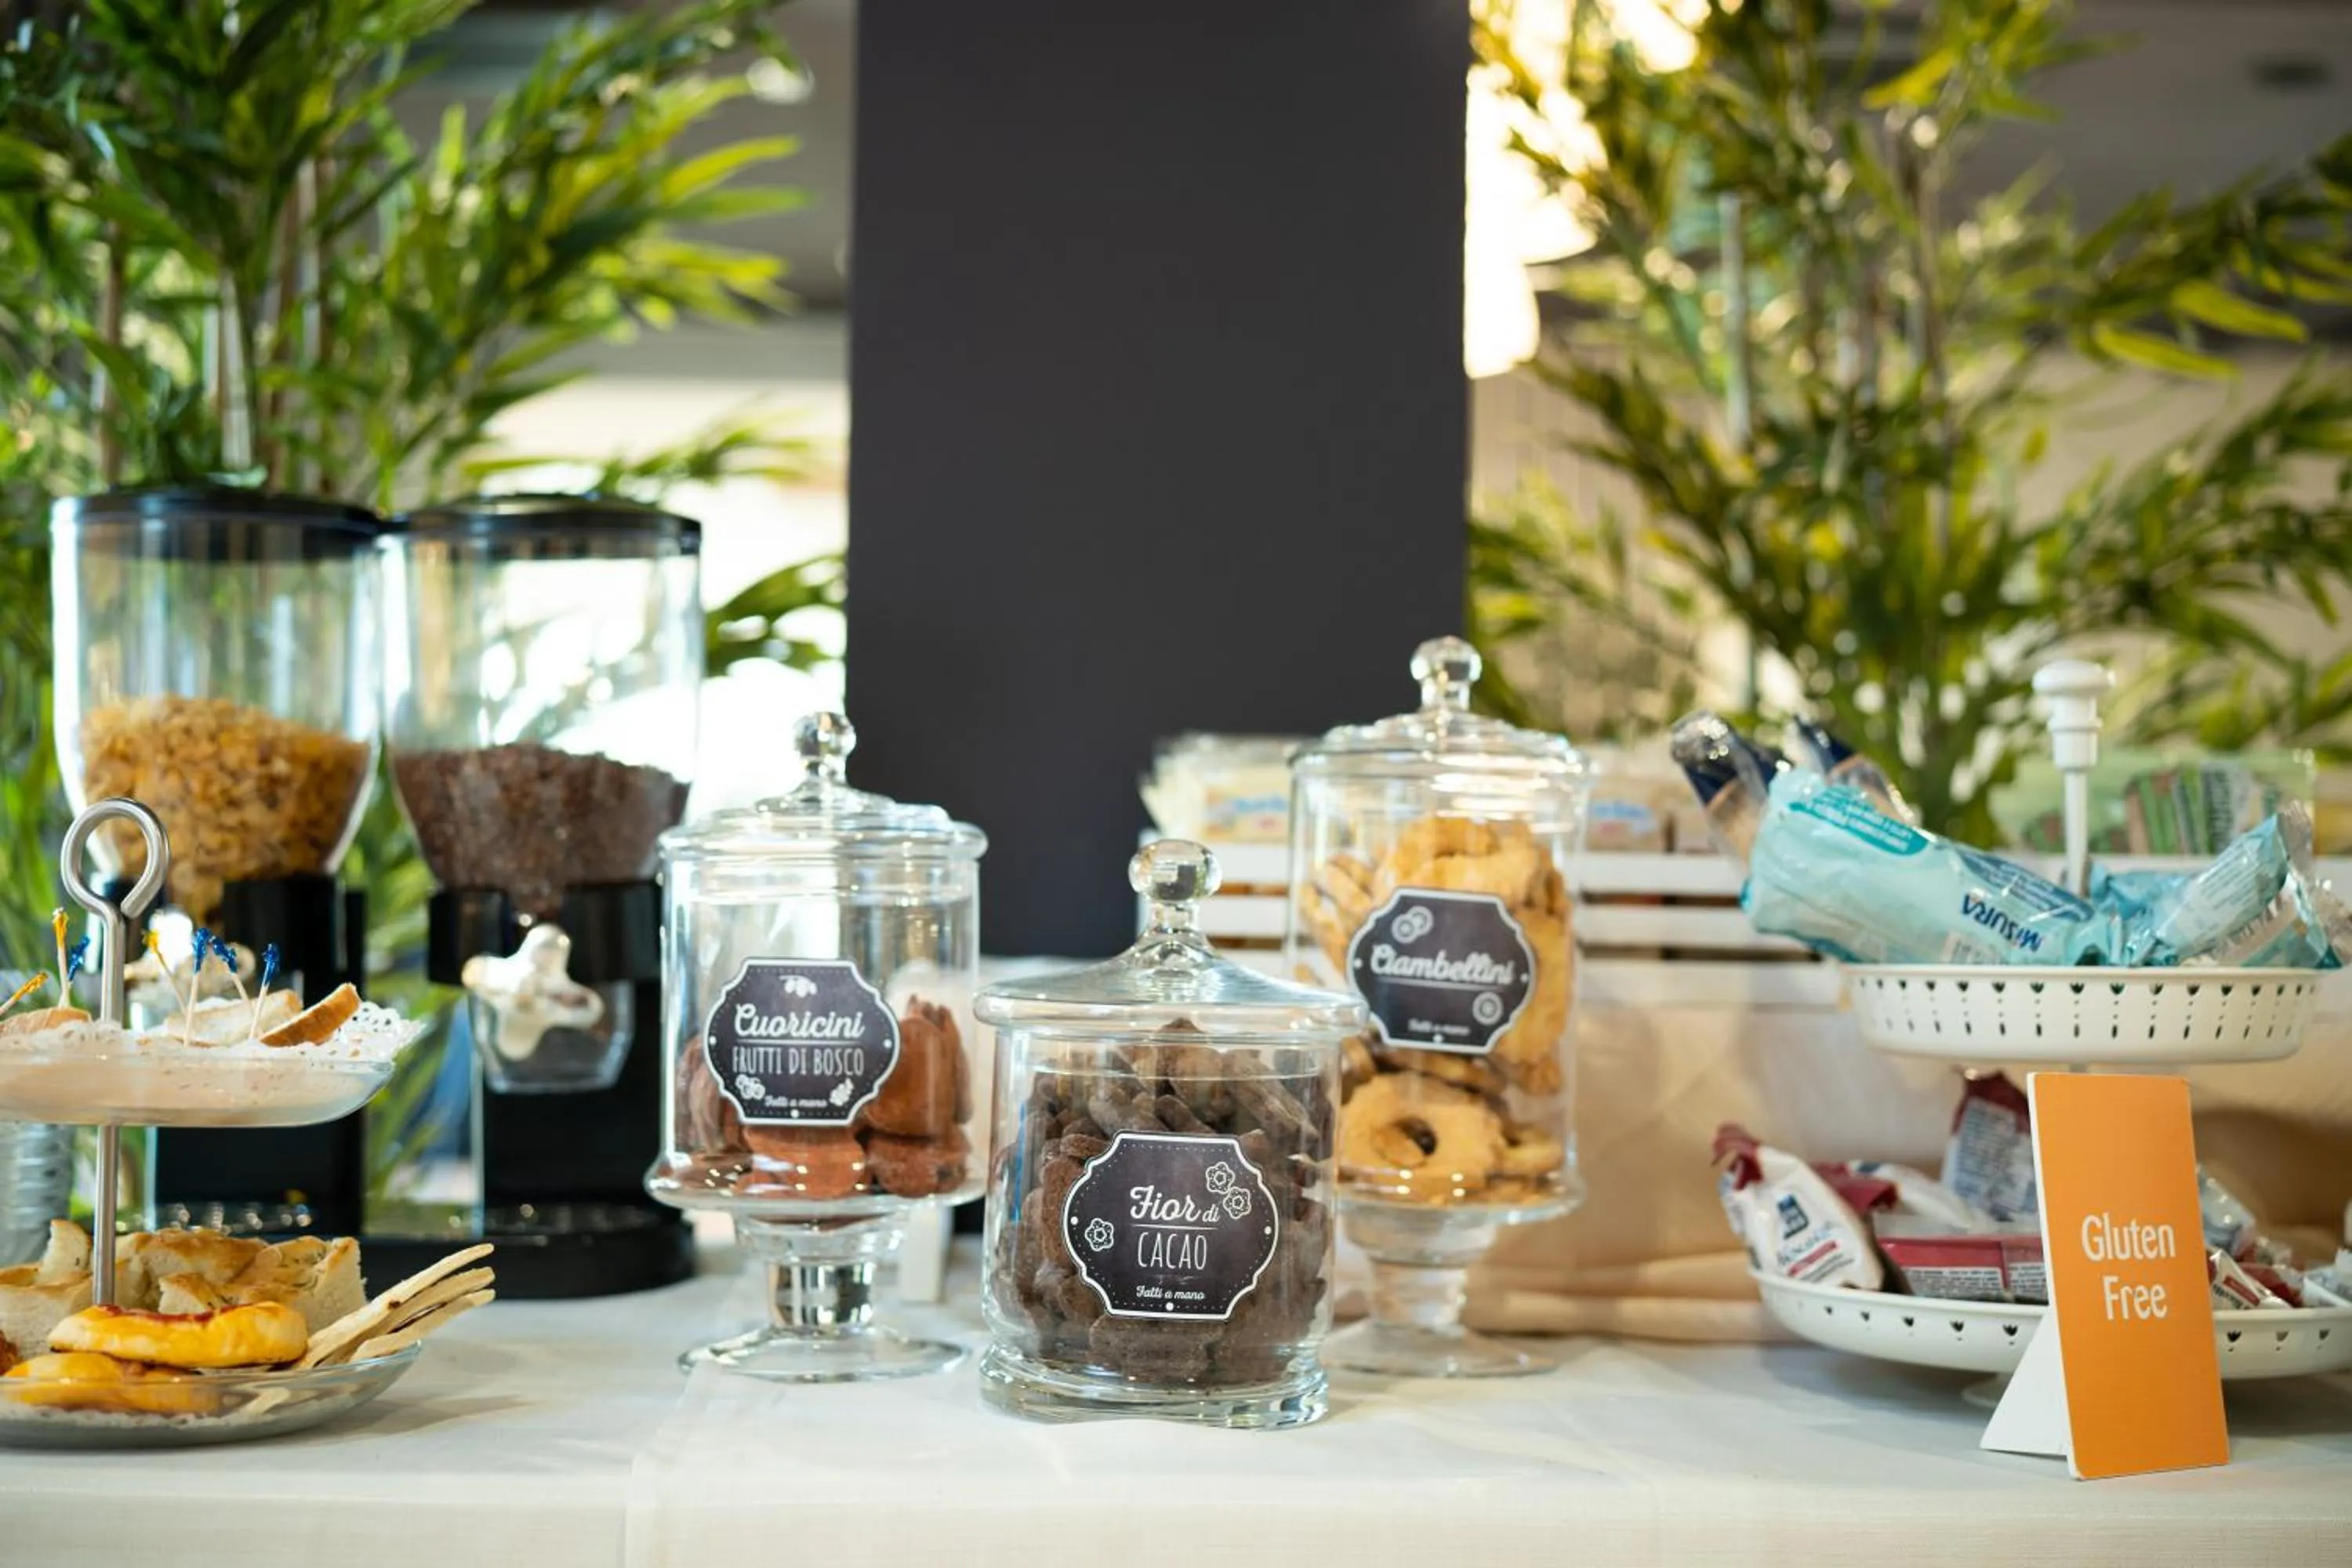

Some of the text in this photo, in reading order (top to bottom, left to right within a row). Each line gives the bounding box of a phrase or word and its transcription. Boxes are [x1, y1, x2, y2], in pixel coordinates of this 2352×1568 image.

[735, 1003, 866, 1038] Cuoricini
[732, 1046, 864, 1076] FRUTTI DI BOSCO
[1130, 1185, 1220, 1223] Fior di
[1138, 1232, 1207, 1270] CACAO
[2082, 1212, 2176, 1261] Gluten
[1136, 1285, 1205, 1300] Fatti a mano
[2103, 1275, 2169, 1320] Free
